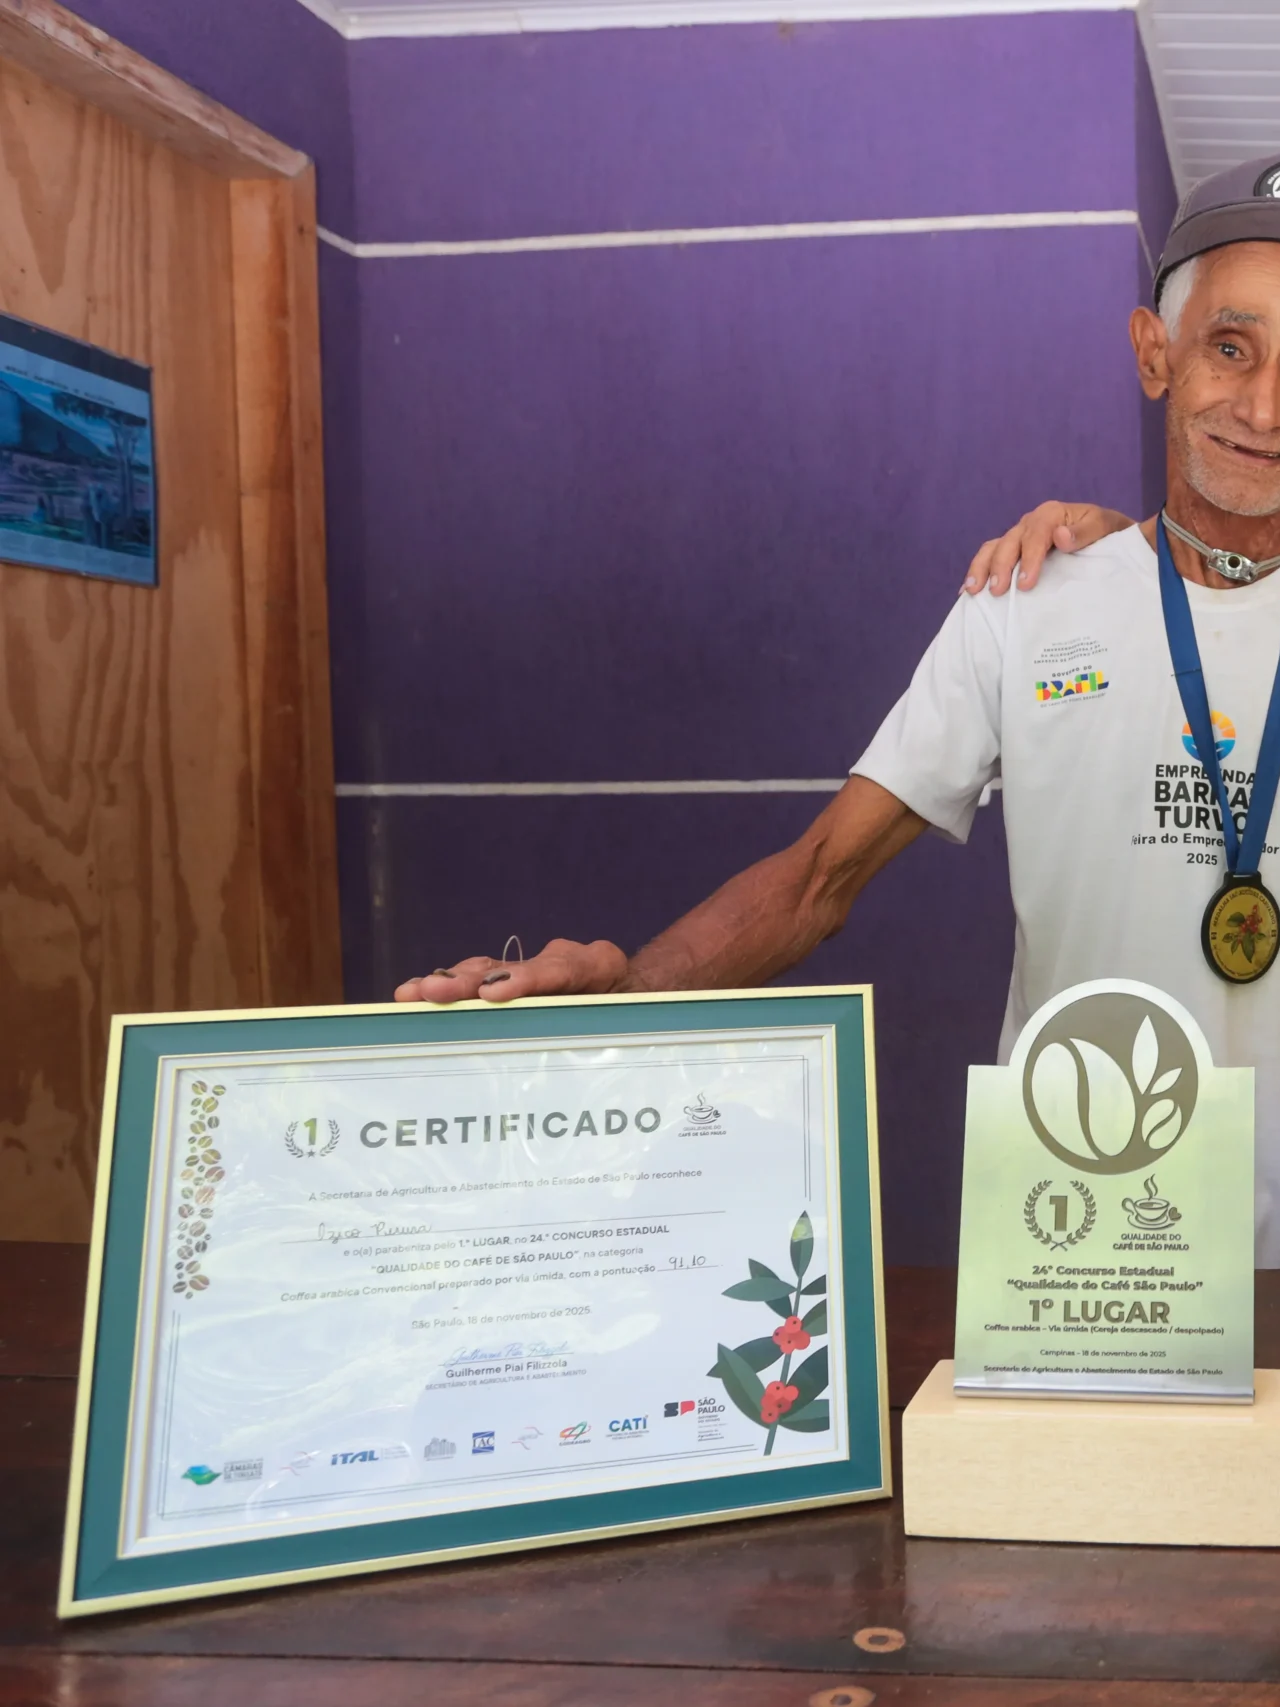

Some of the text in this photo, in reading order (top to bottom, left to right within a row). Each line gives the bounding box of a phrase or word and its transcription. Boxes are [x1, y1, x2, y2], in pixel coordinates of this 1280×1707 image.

[1035, 670, 1109, 702] BRASIL
[1155, 764, 1255, 785] EMPRENDA
[1161, 833, 1178, 844] do
[1186, 852, 1218, 865] 2025
[303, 1117, 318, 1146] 1
[360, 1107, 661, 1149] CERTIFICADO
[308, 1193, 317, 1201] A
[320, 1190, 372, 1201] Secretaria
[375, 1188, 389, 1197] de
[391, 1185, 447, 1198] Agricultura
[459, 1179, 534, 1192] Abastecimento
[536, 1178, 549, 1187] do
[588, 1174, 600, 1184] de
[623, 1171, 650, 1181] Paulo
[652, 1169, 702, 1180] reconhece
[1049, 1195, 1068, 1232] 1
[353, 1246, 372, 1257] o(a)
[375, 1242, 431, 1256] parabeniza
[434, 1241, 456, 1252] pelo
[514, 1236, 527, 1244] no
[552, 1229, 613, 1242] CONCURSO
[616, 1225, 670, 1237] ESTADUAL
[1121, 1233, 1182, 1241] QUALIDADE DO
[1112, 1241, 1133, 1251] CAFÉ
[1147, 1241, 1162, 1251] SÃO
[1163, 1243, 1190, 1251] PAULO
[444, 1260, 460, 1269] DO
[463, 1254, 493, 1267] CAFÉ
[495, 1255, 511, 1265] DE
[513, 1251, 536, 1264] SÃO
[584, 1251, 595, 1259] na
[598, 1246, 644, 1258] categoria
[1056, 1265, 1116, 1276] Concurso
[1119, 1266, 1175, 1276] Estadual
[281, 1291, 317, 1302] Coffea
[319, 1289, 360, 1299] arabica
[362, 1281, 436, 1295] Convencional
[438, 1277, 492, 1291] preparado
[495, 1275, 512, 1286] por
[514, 1274, 529, 1283] via
[569, 1270, 591, 1279] com
[602, 1264, 656, 1277] pontuação
[1081, 1280, 1098, 1290] do
[1101, 1280, 1130, 1290] Café
[1133, 1280, 1157, 1291] São
[411, 1318, 430, 1330] São
[467, 1315, 478, 1325] 18
[481, 1313, 494, 1324] de
[496, 1309, 548, 1323] novembro
[550, 1308, 563, 1318] de
[1063, 1300, 1170, 1324] LUGAR
[1011, 1324, 1040, 1332] arabica
[1063, 1325, 1088, 1333] úmida
[1090, 1325, 1119, 1334] (Cereja
[1120, 1326, 1167, 1334] descascado
[1174, 1327, 1225, 1336] despolpado)
[1040, 1349, 1076, 1357] Campinas
[446, 1359, 567, 1379] Guilherme Piai Filizzola
[1032, 1366, 1073, 1374] Agricultura
[468, 1379, 478, 1387] DE
[479, 1374, 525, 1385] AGRICULTURA
[697, 1396, 716, 1407] SÃO
[697, 1404, 726, 1415] PAULO
[608, 1417, 647, 1433] CATI
[472, 1435, 496, 1448] IAC
